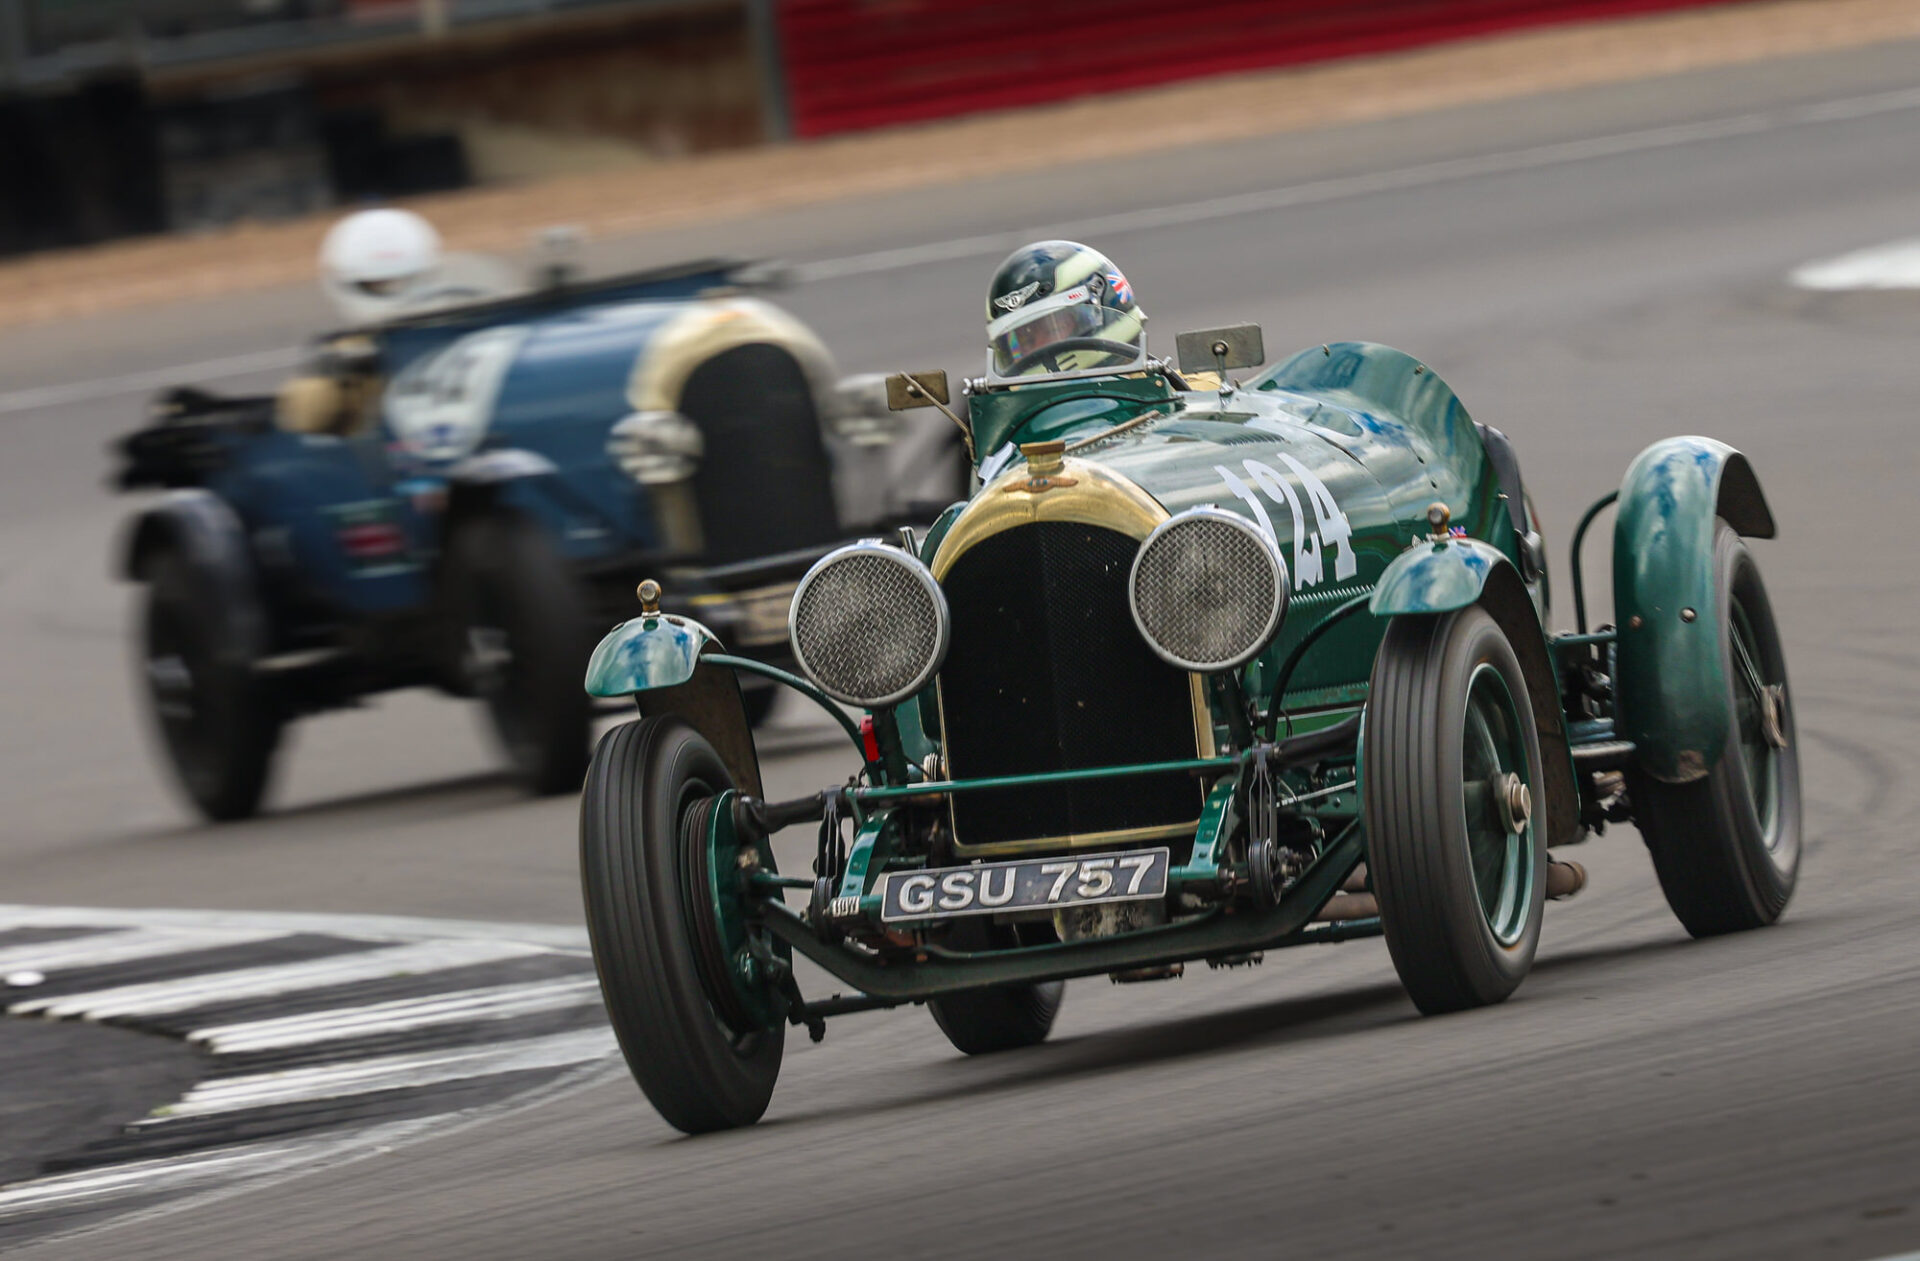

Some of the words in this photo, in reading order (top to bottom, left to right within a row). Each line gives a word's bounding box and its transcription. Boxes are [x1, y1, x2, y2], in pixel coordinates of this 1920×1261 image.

[1214, 452, 1357, 591] 124
[899, 867, 1017, 913] GSU
[1041, 854, 1155, 904] 757
